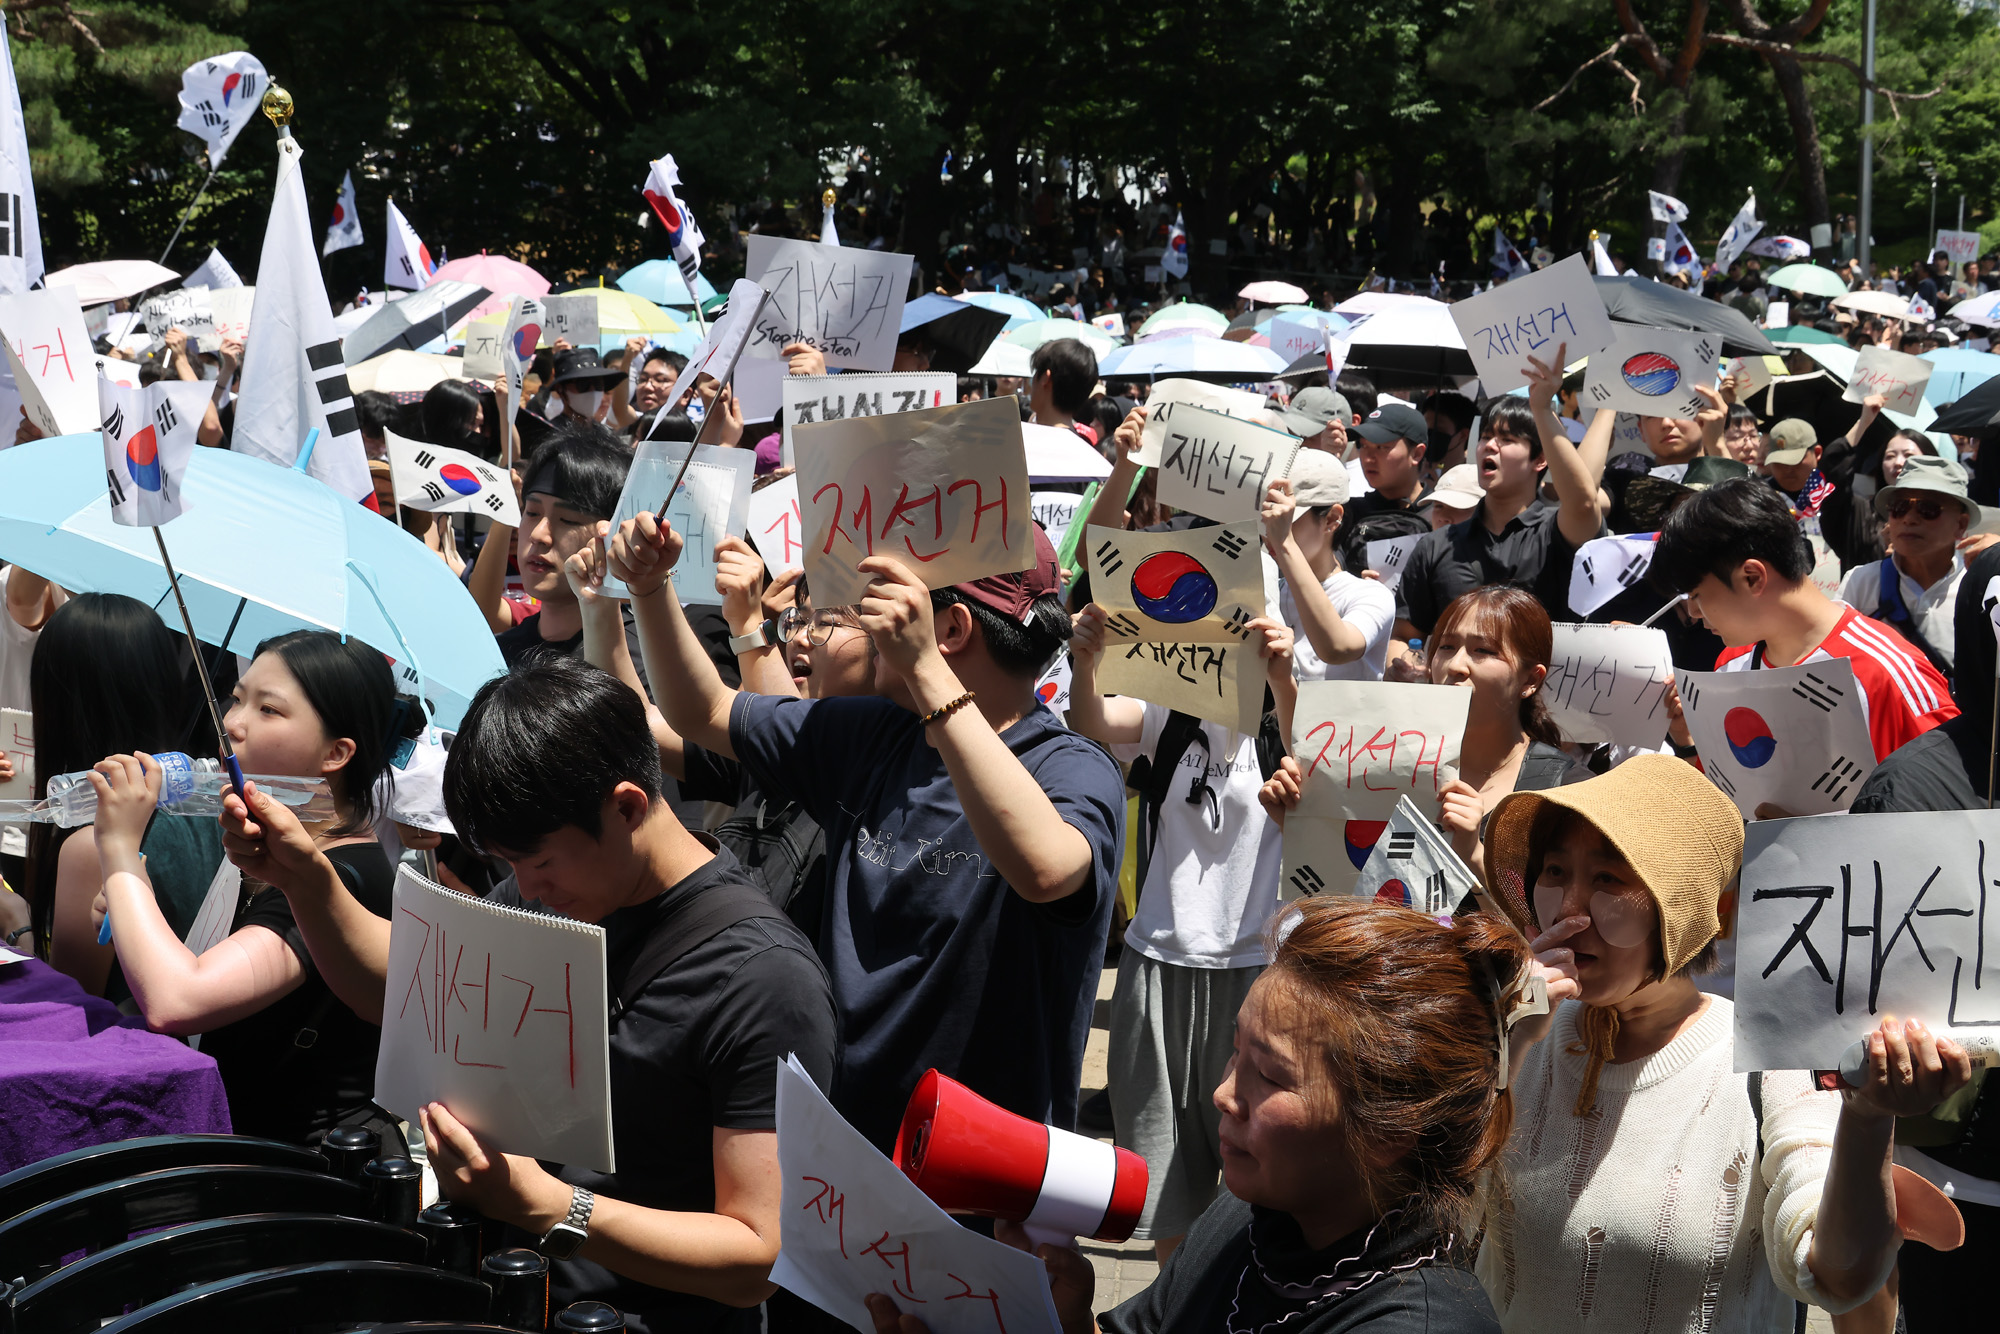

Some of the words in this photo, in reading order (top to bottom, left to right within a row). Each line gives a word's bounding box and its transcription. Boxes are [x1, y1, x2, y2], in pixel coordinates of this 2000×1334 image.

[764, 260, 894, 340] 재선거
[1474, 302, 1576, 359] 재선거
[1164, 433, 1274, 511] 재선거
[1545, 655, 1668, 720] 재선거
[1305, 721, 1444, 792] 재선거
[1752, 839, 2000, 1028] 재선
[400, 907, 575, 1088] 재선거
[802, 1176, 1010, 1334] 재선거
